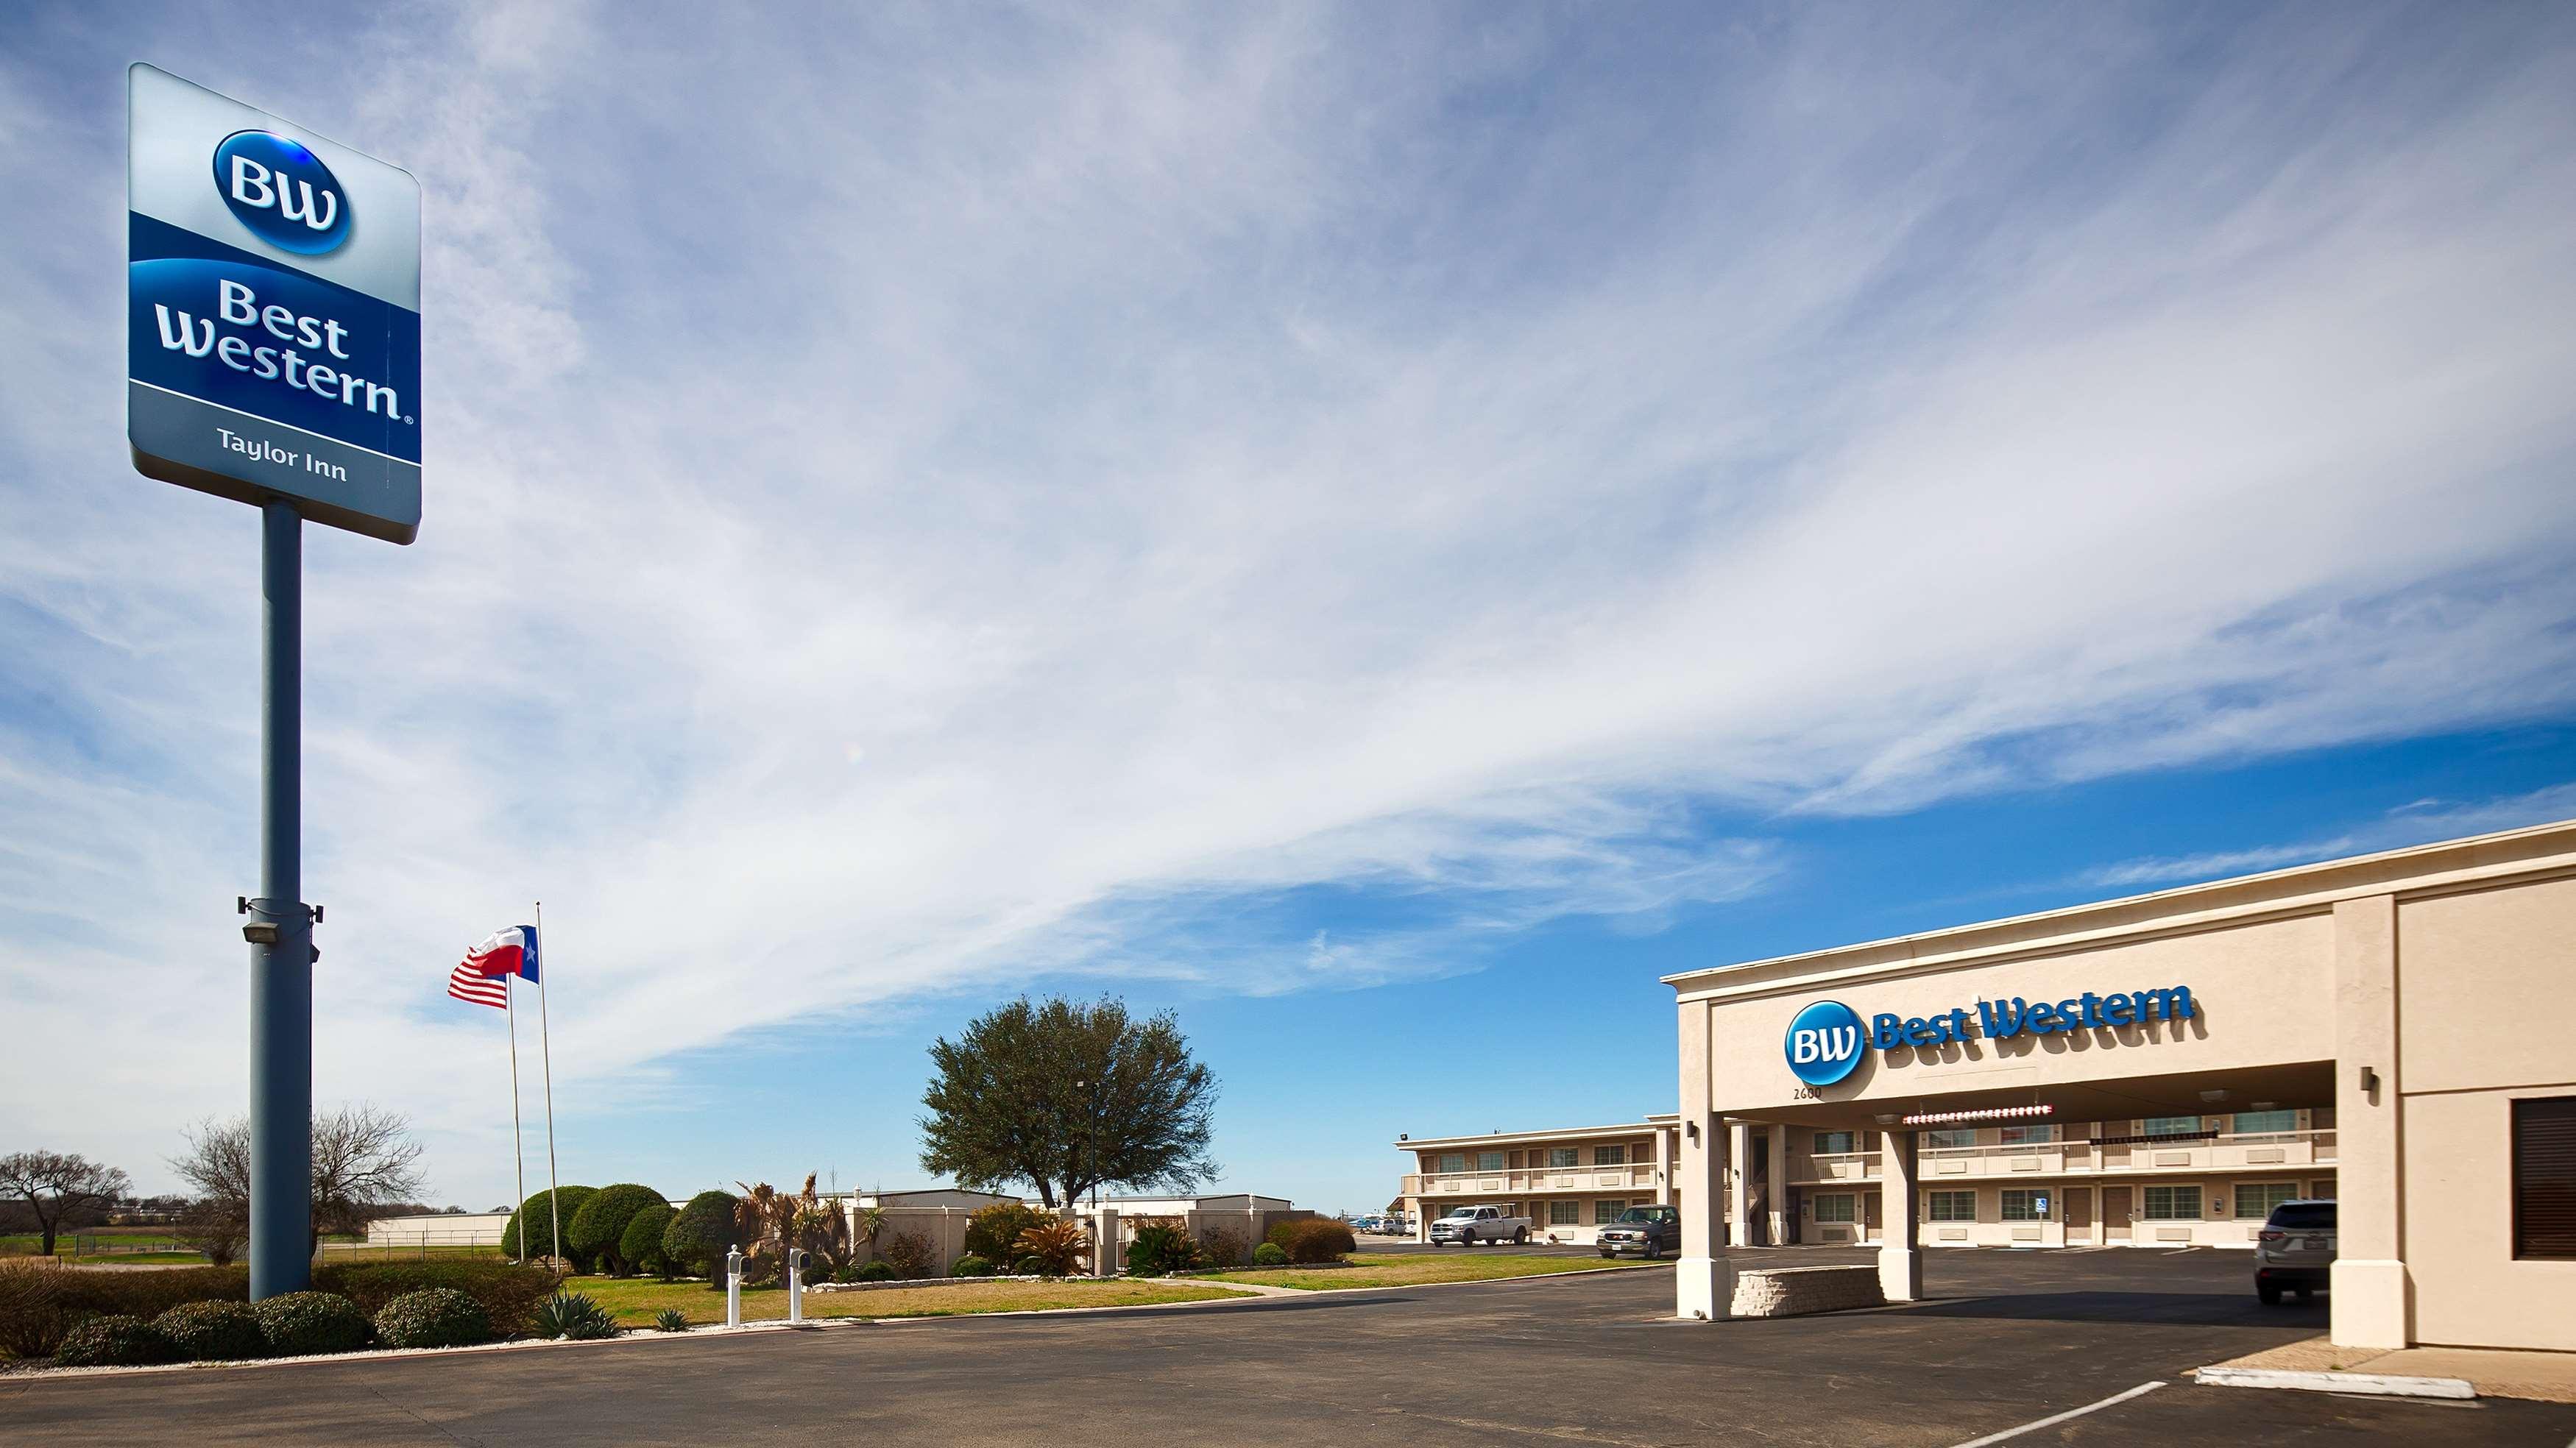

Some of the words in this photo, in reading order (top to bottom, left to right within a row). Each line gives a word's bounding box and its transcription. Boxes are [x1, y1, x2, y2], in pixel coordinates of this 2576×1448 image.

[230, 155, 337, 231] BW
[220, 279, 350, 360] Best
[155, 303, 401, 420] Western
[217, 428, 298, 467] Taylor
[306, 454, 347, 483] Inn
[1794, 1027, 1856, 1064] BW
[1873, 1008, 1970, 1050] Best
[1978, 985, 2196, 1037] Western
[1794, 1087, 1822, 1100] 2600
